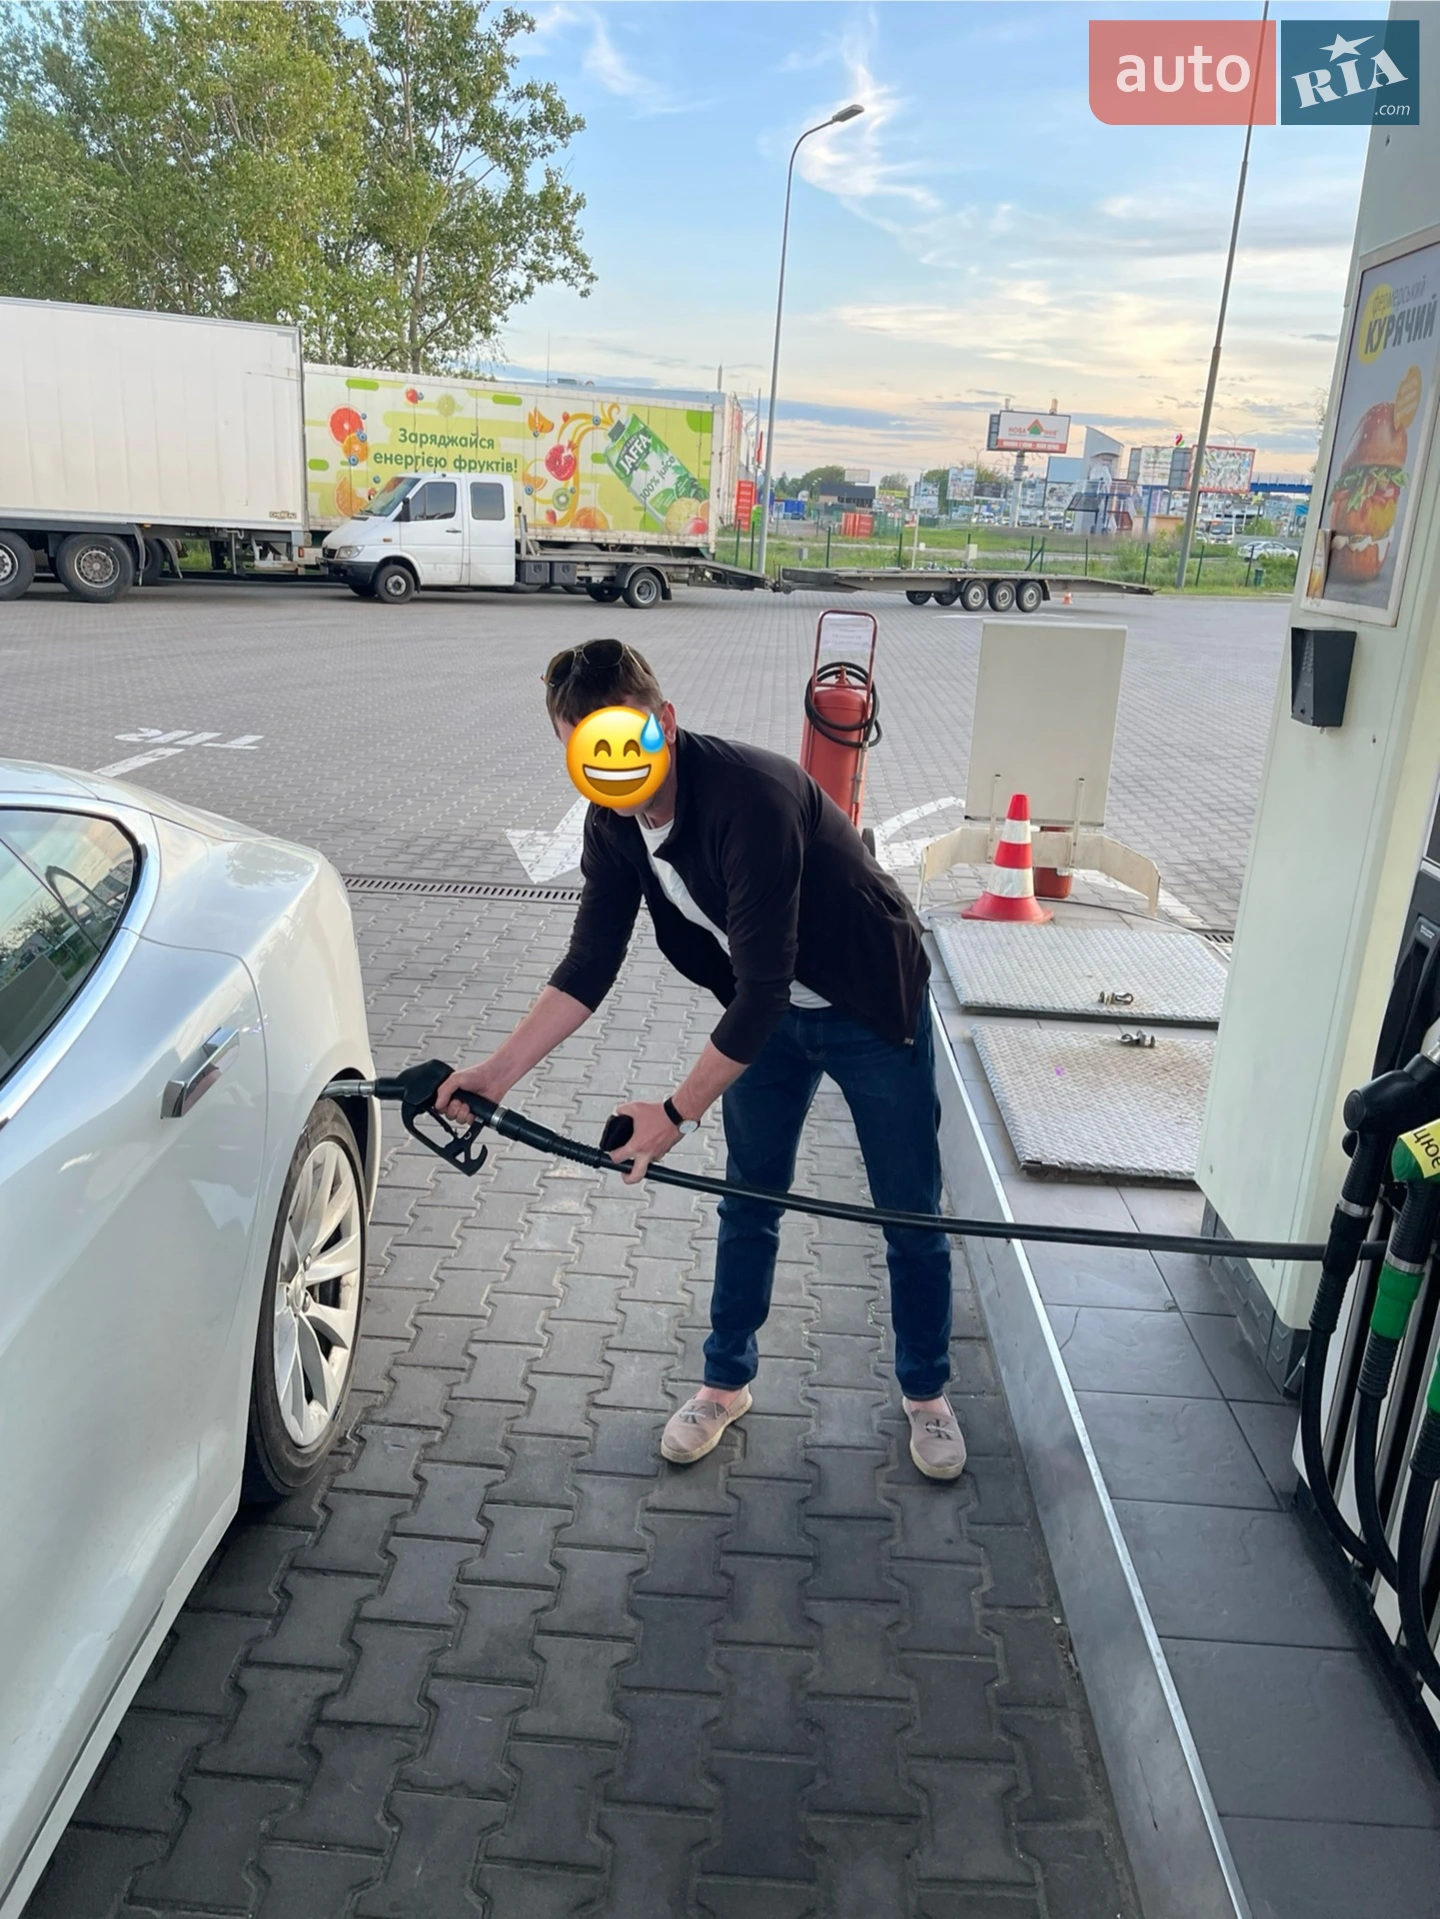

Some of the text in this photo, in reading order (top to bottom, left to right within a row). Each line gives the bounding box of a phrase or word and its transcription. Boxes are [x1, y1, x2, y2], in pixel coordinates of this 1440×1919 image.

[1364, 293, 1438, 355] КУРЯЧИЙ
[398, 427, 495, 450] Заряджайся
[619, 433, 651, 475] JAFFA
[373, 451, 518, 473] енергією фруктів!
[639, 476, 660, 500] 100%
[658, 455, 676, 479] juice
